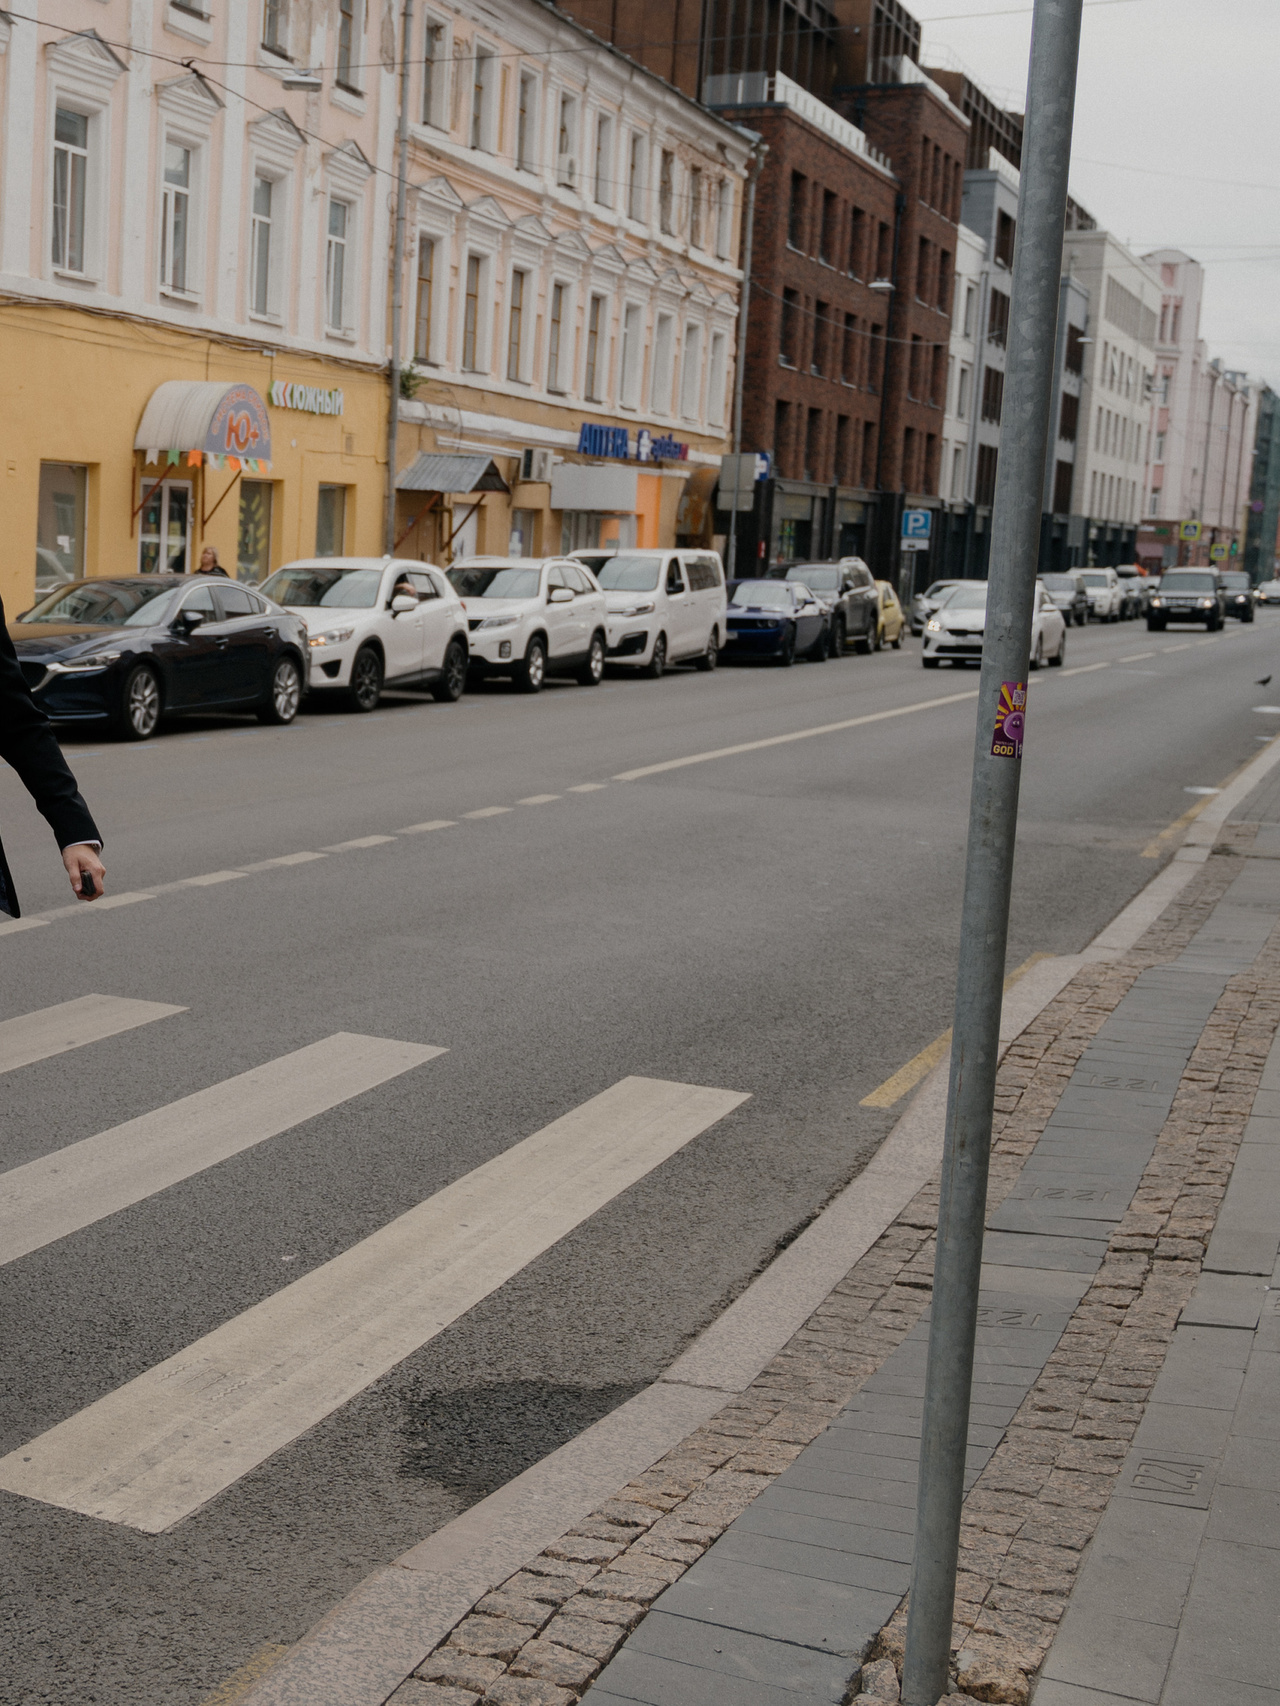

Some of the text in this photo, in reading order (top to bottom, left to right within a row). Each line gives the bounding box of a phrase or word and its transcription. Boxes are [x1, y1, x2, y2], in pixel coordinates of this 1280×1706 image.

[292, 383, 344, 415] ЮЖНЫЙ
[577, 422, 629, 459] АПТЕКА
[907, 514, 925, 534] P
[993, 744, 1014, 756] GOD
